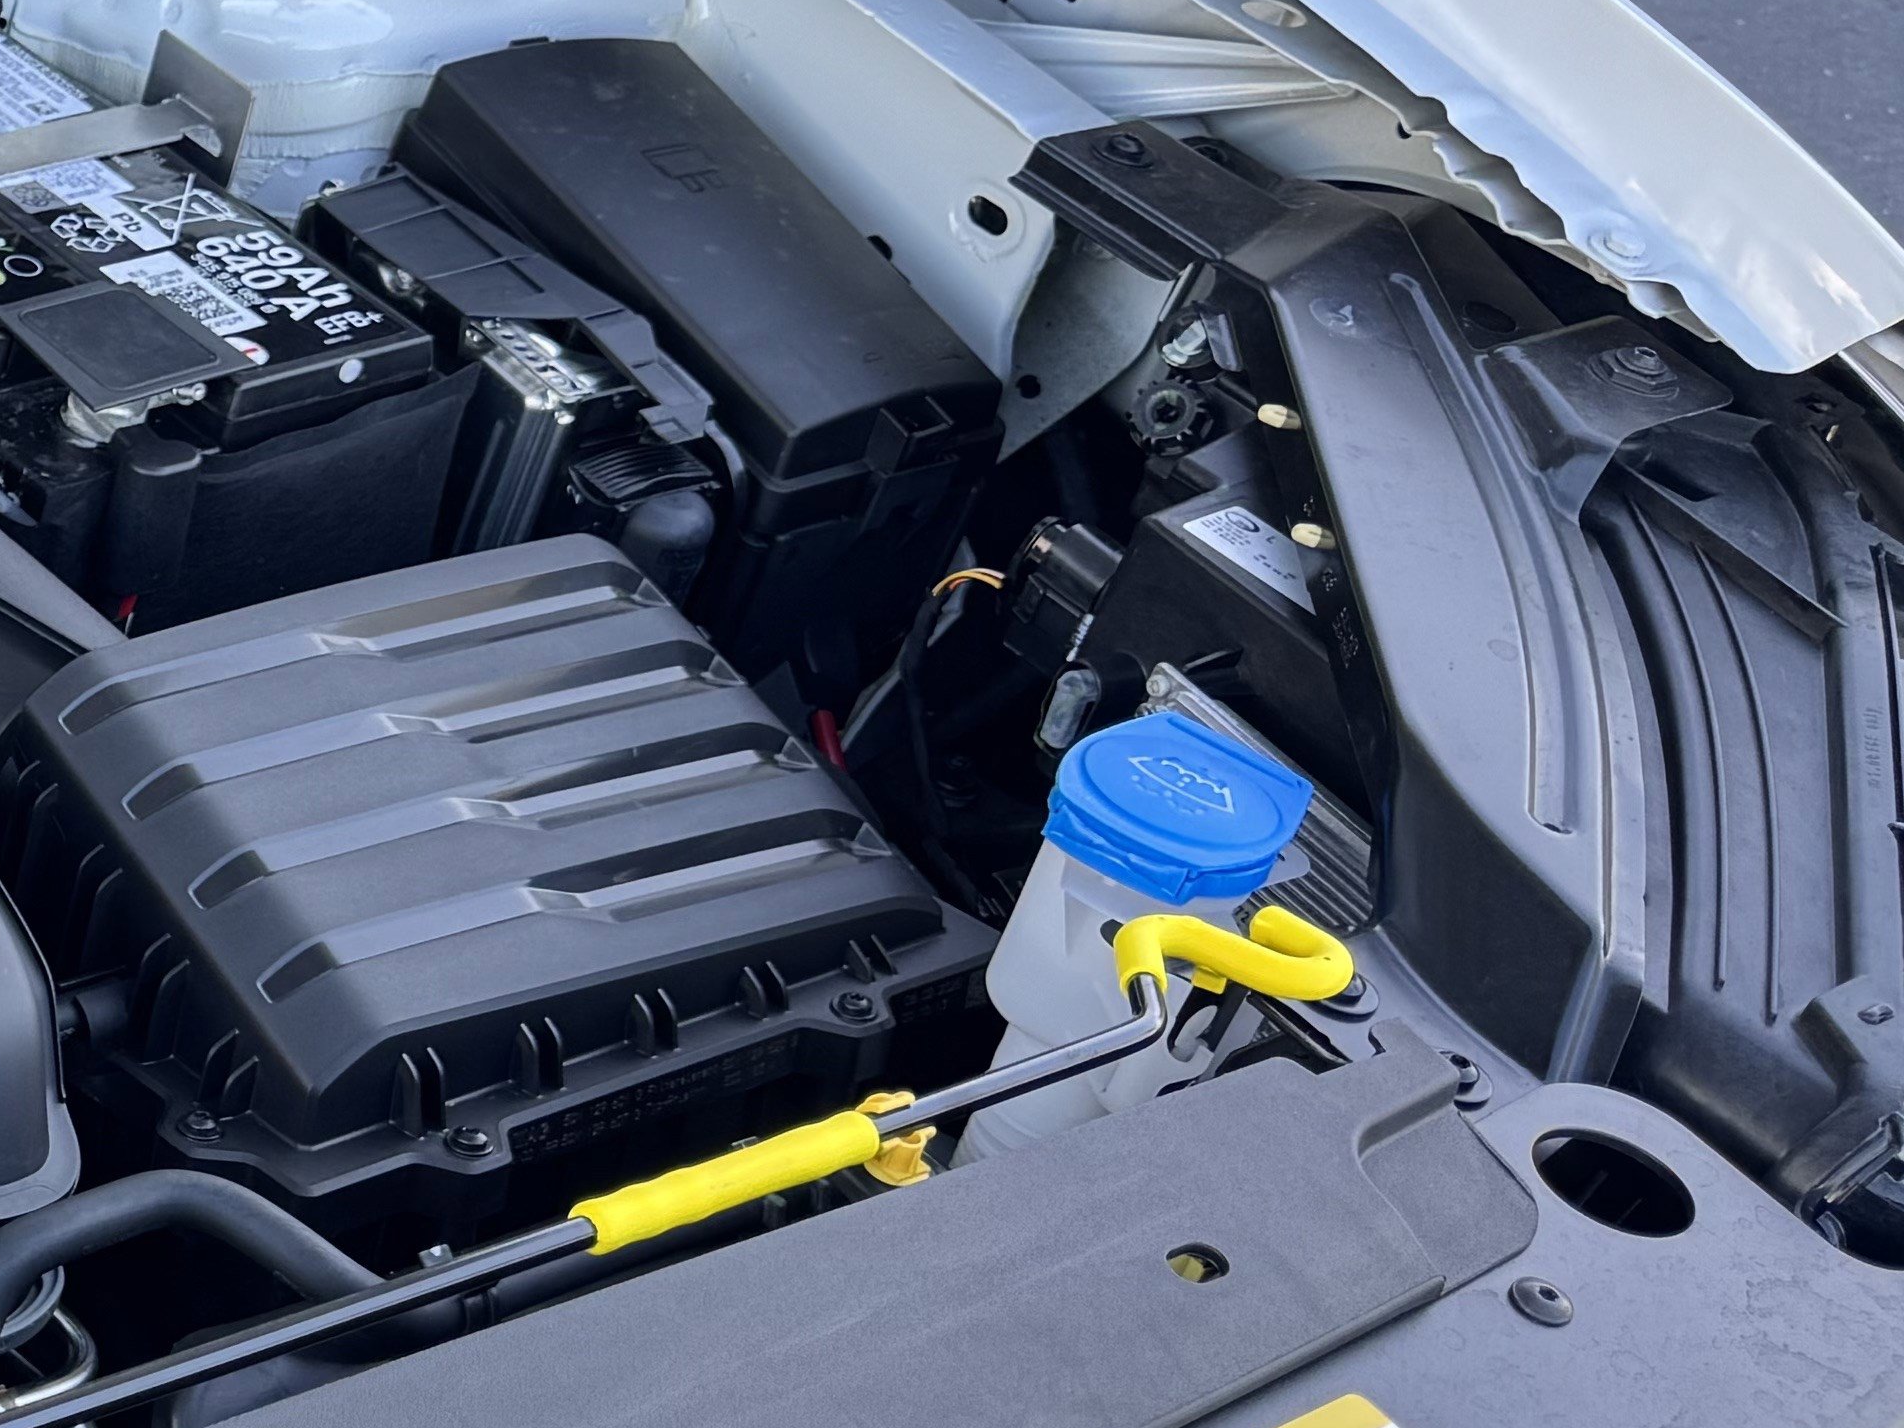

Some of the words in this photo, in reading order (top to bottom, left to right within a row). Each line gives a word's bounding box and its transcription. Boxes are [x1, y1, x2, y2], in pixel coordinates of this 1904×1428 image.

[112, 213, 141, 232] Pb
[196, 236, 287, 290] 640
[235, 230, 353, 308] 59Ah
[315, 311, 386, 335] EFB+
